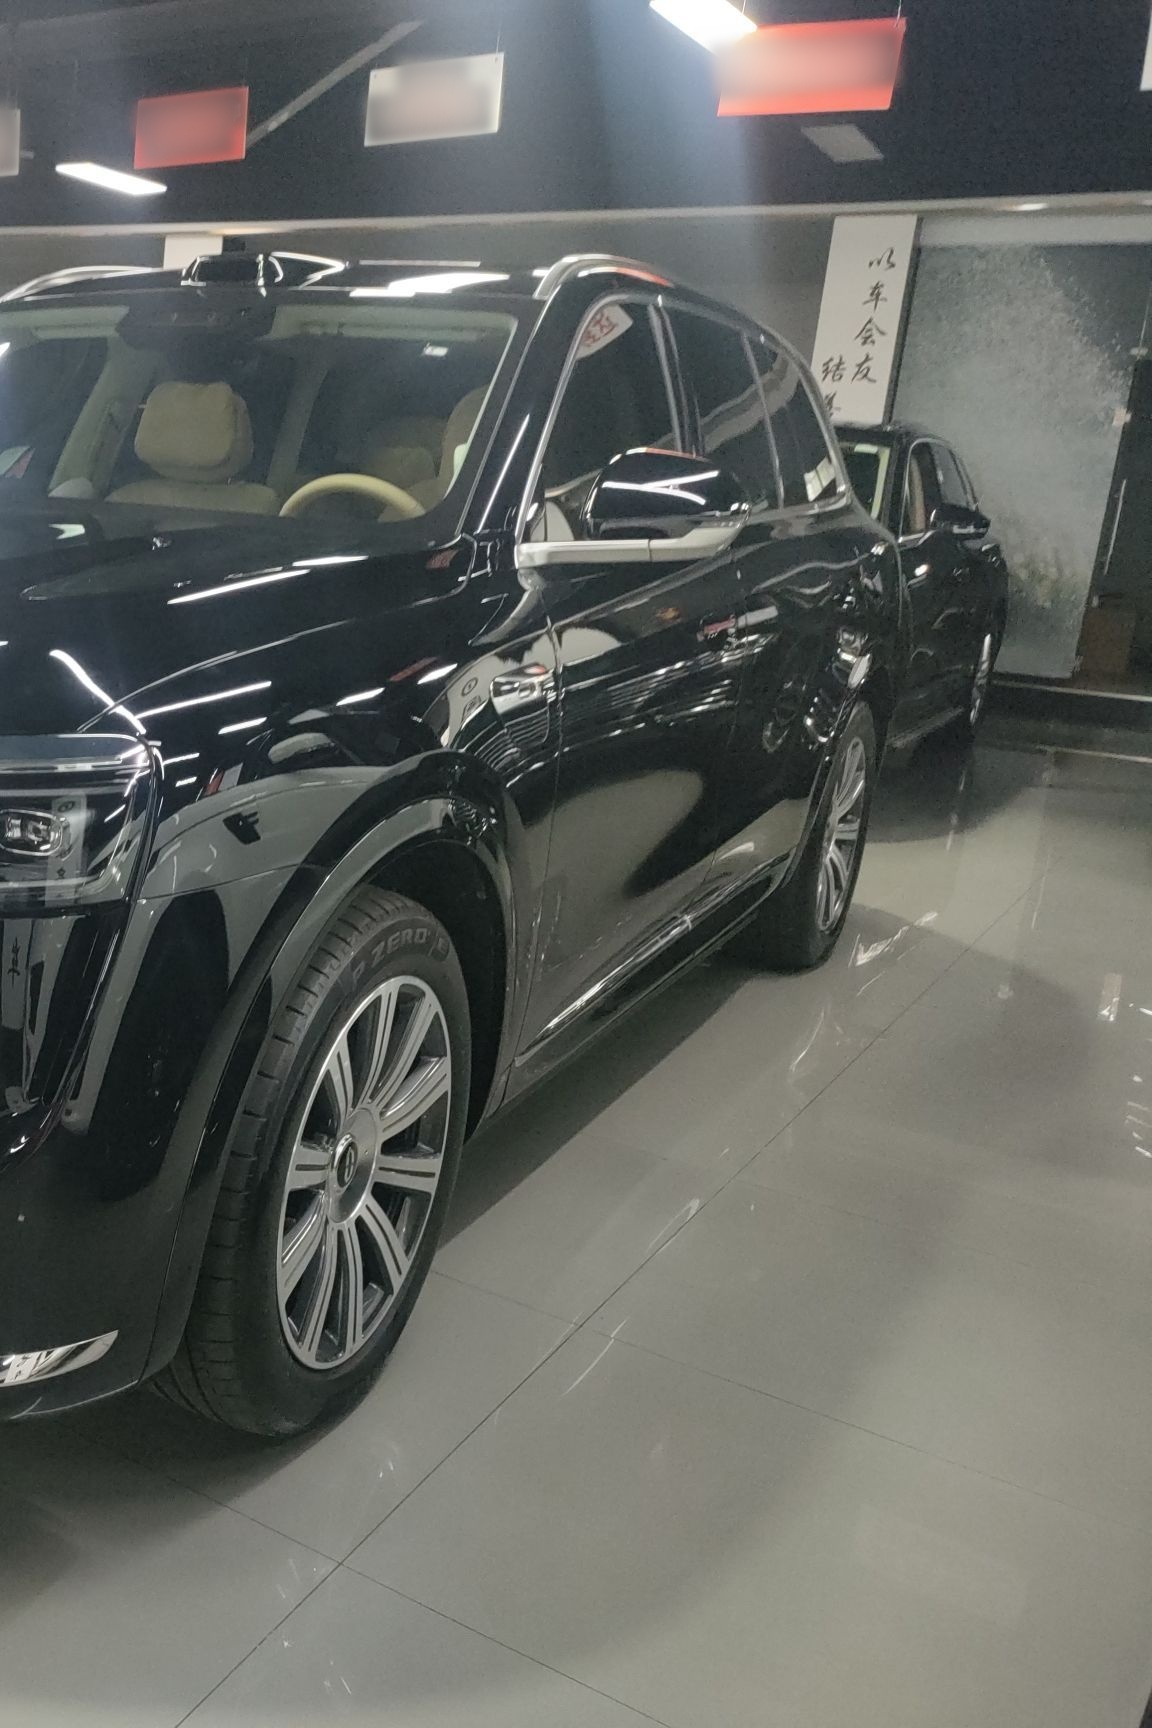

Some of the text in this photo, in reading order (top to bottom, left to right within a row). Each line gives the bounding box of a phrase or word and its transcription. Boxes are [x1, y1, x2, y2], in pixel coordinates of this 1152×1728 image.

[851, 247, 896, 384] 以车会友
[371, 927, 429, 968] ZERO
